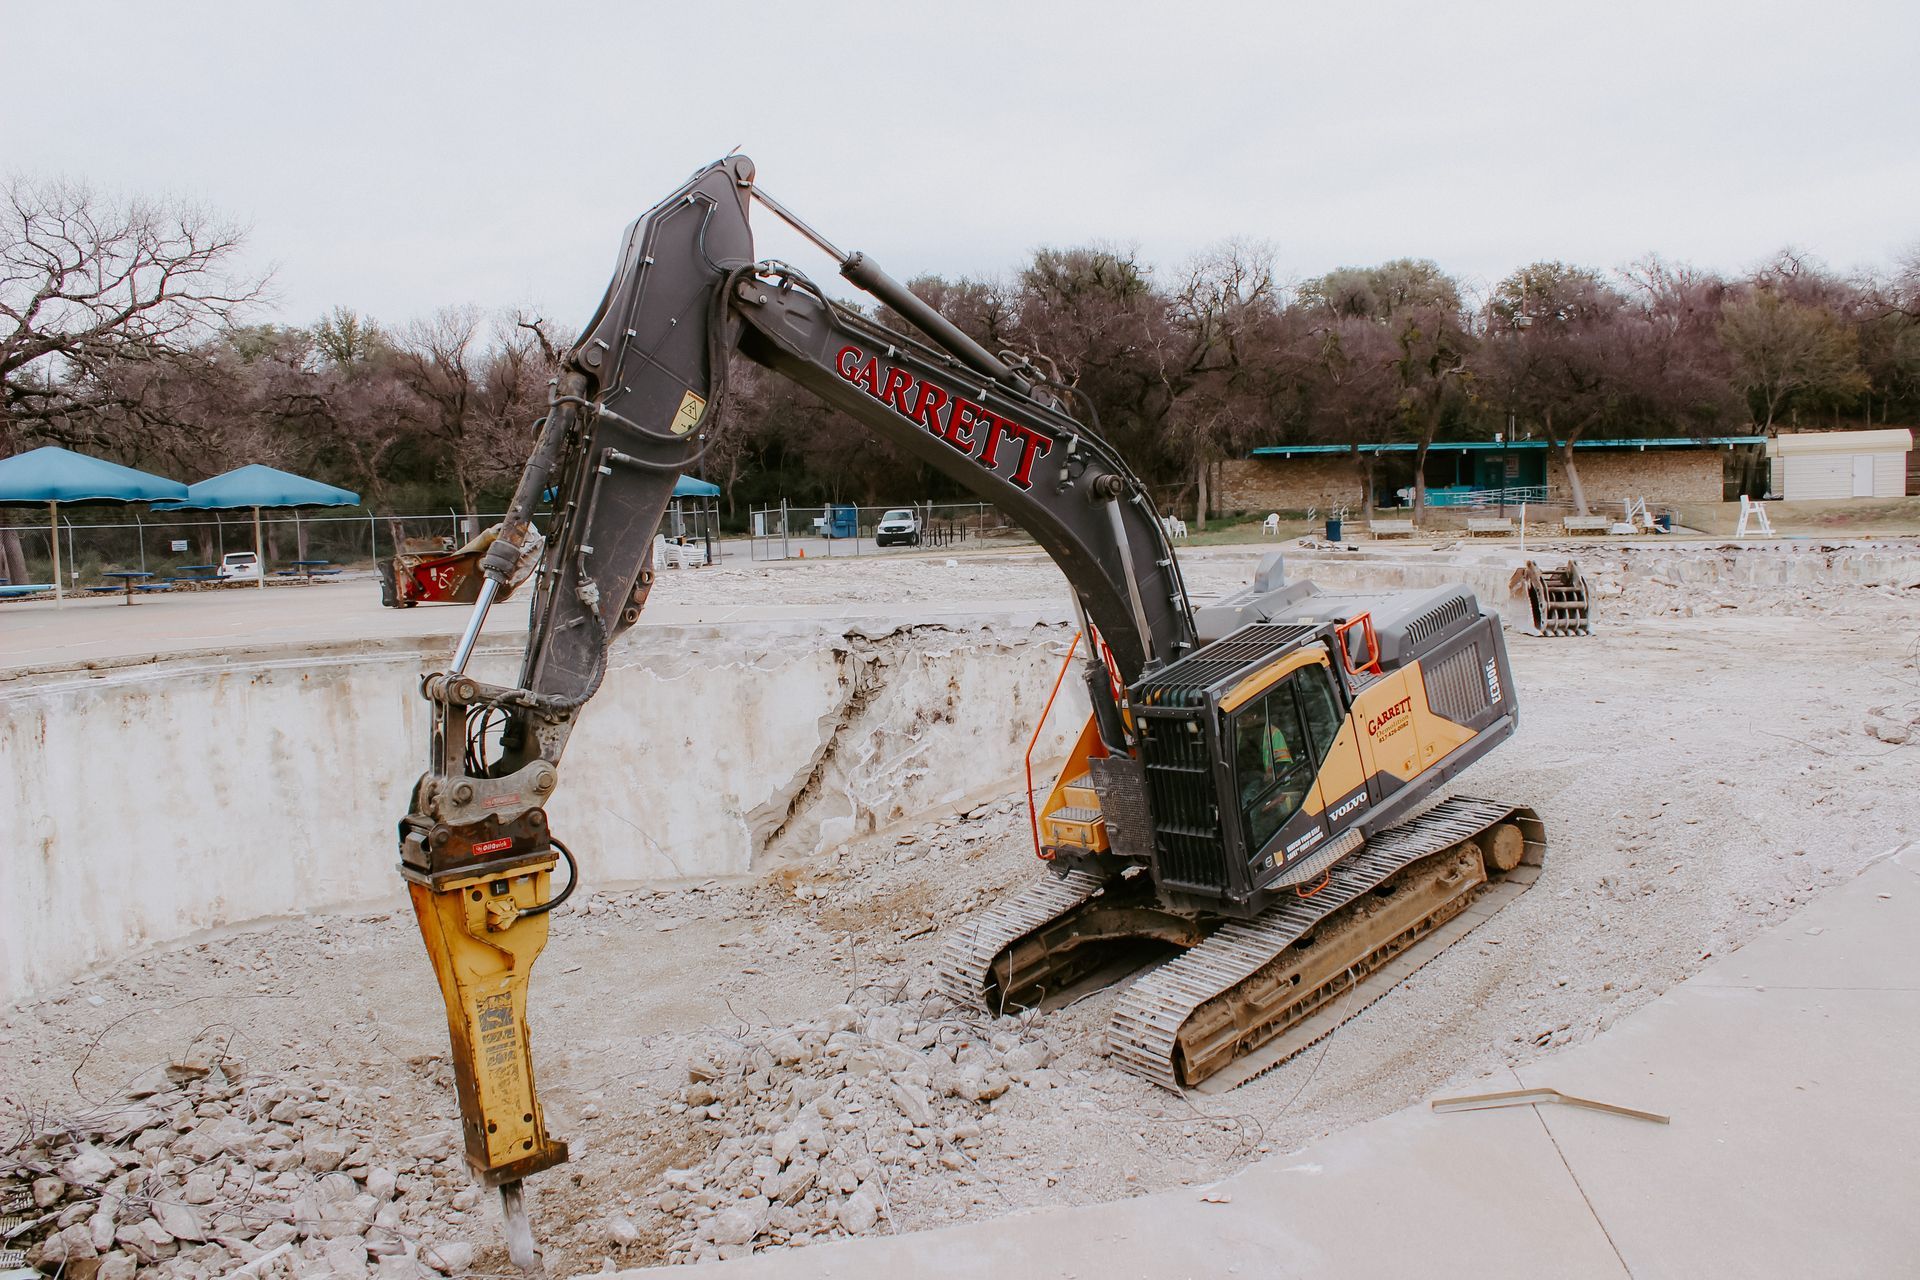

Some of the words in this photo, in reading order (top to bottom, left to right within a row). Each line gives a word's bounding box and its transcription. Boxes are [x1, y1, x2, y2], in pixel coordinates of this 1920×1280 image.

[835, 345, 1053, 492] GARRETT
[1368, 696, 1412, 736] GARRETT
[1376, 715, 1409, 738] Demolition
[1329, 791, 1368, 822] VOLVO
